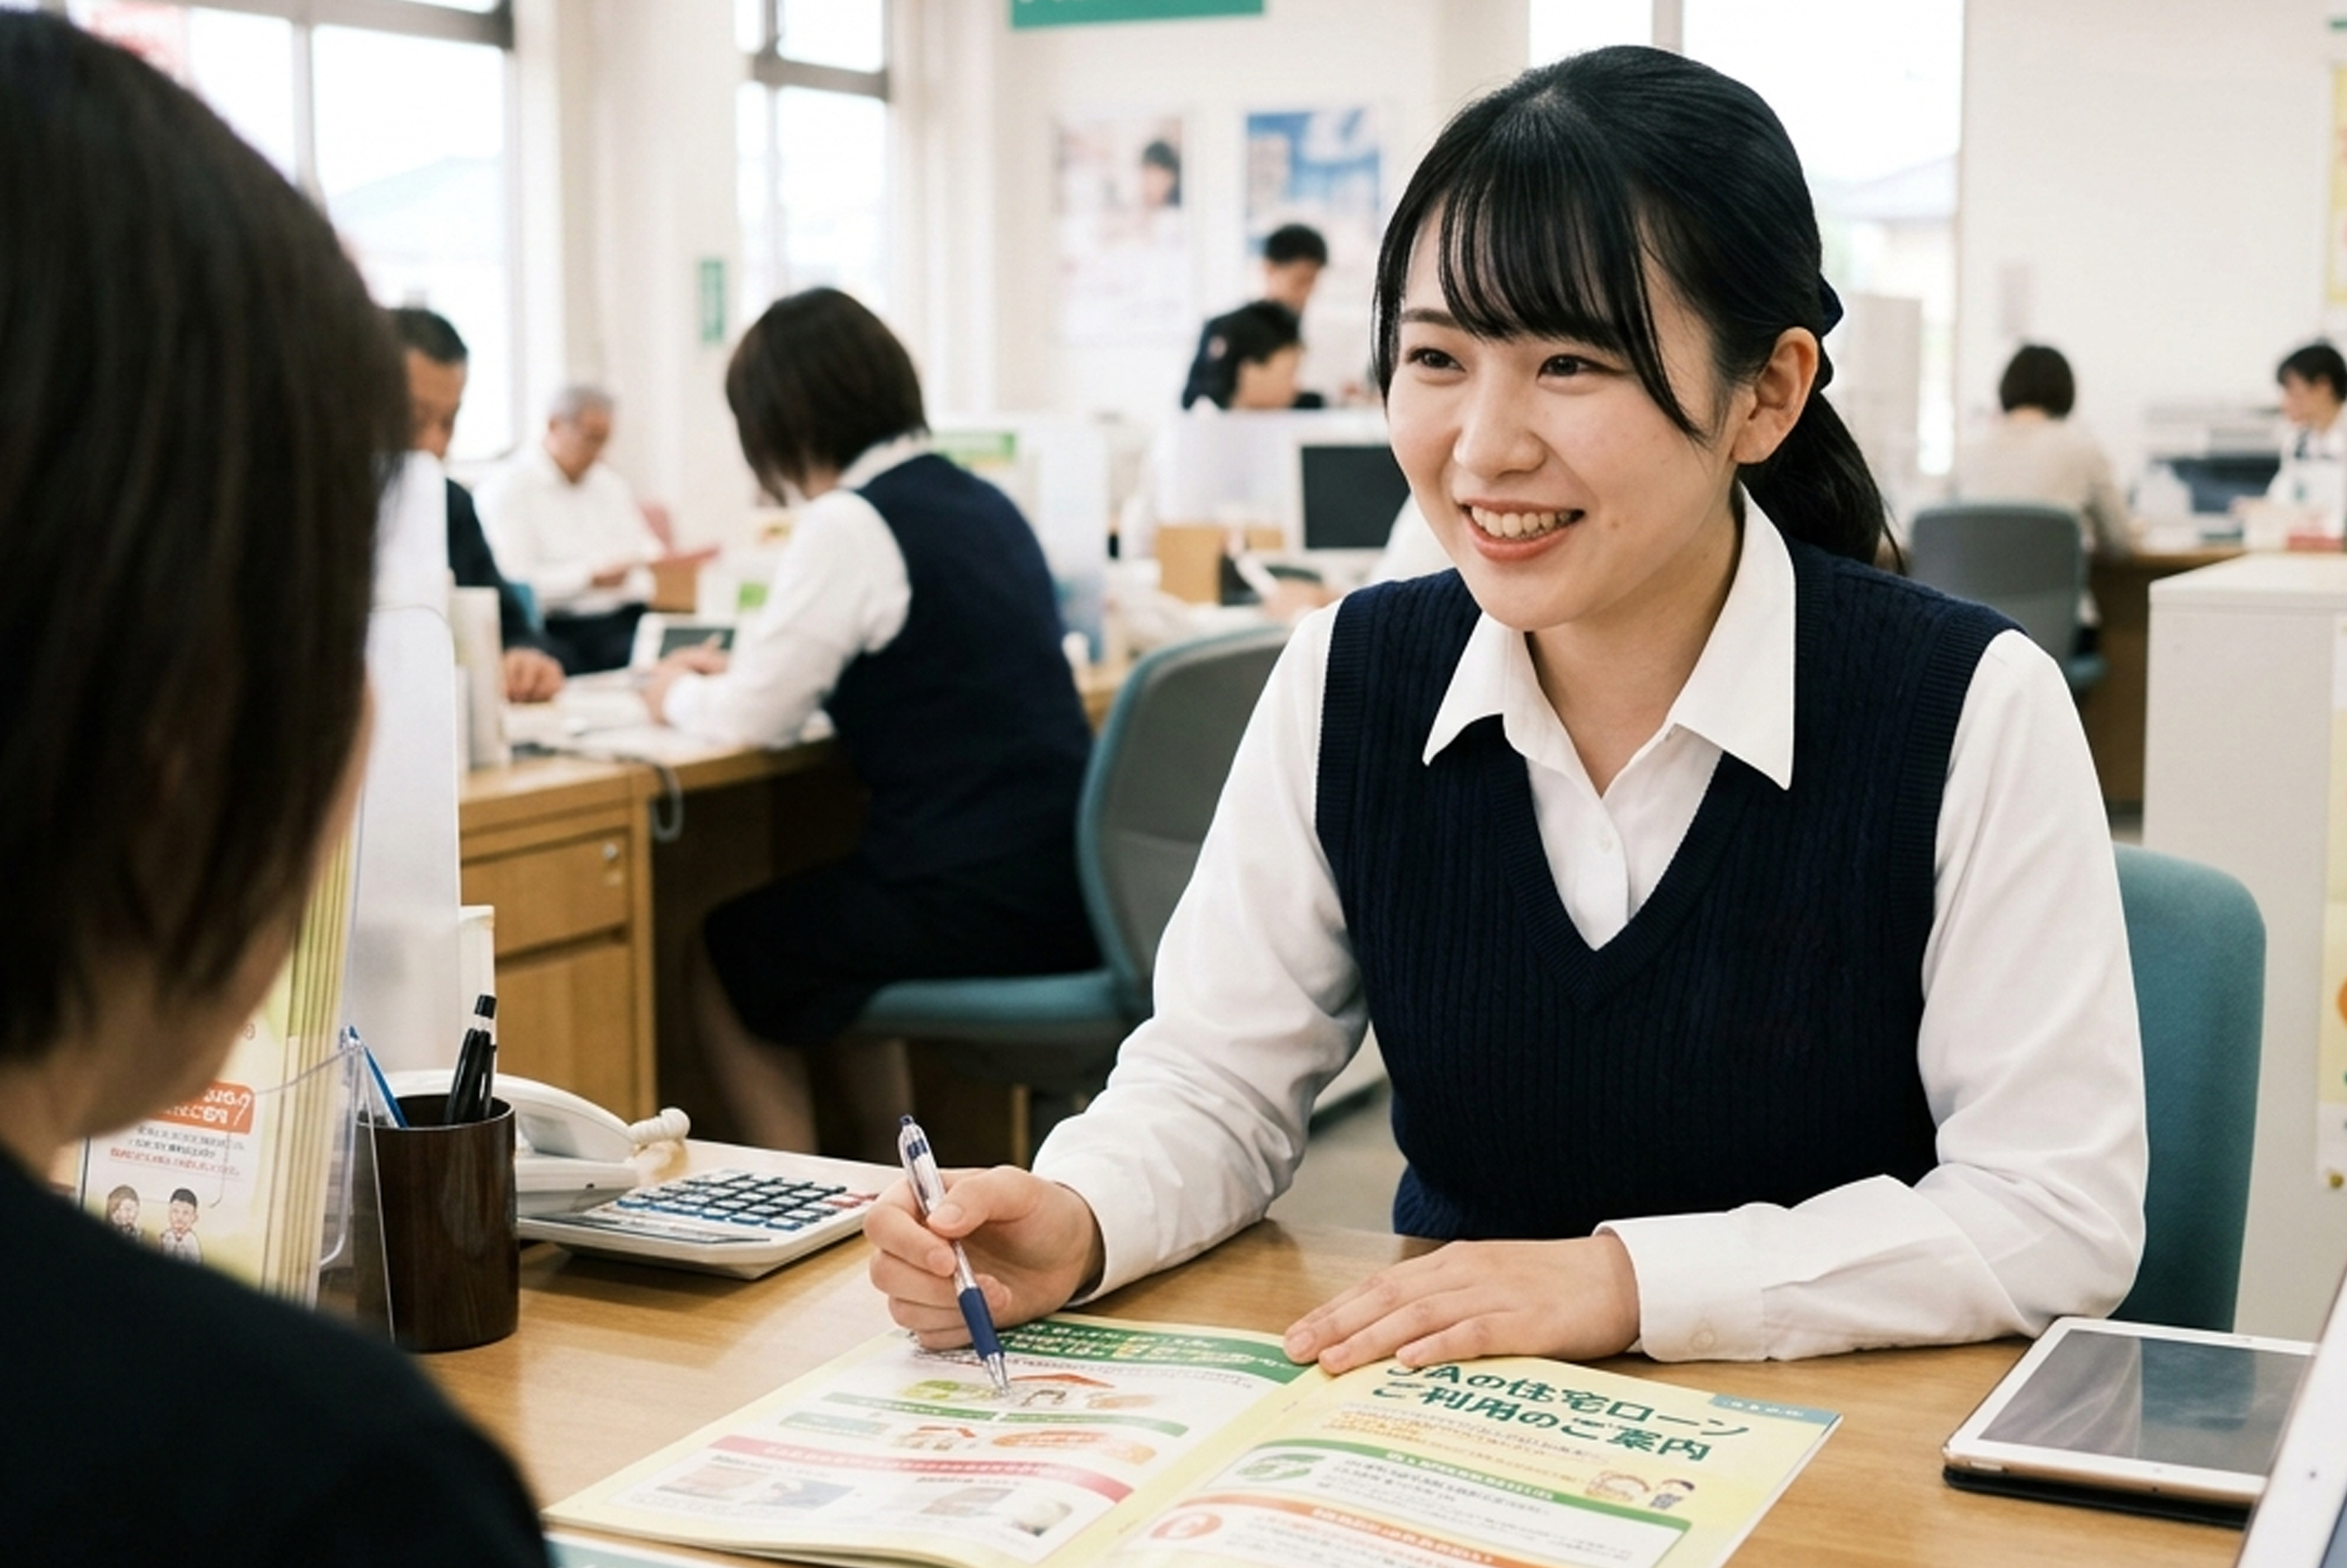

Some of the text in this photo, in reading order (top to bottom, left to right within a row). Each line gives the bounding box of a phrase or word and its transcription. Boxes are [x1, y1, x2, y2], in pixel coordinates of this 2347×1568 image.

[1372, 1381, 1712, 1461] ご利用のご案内
